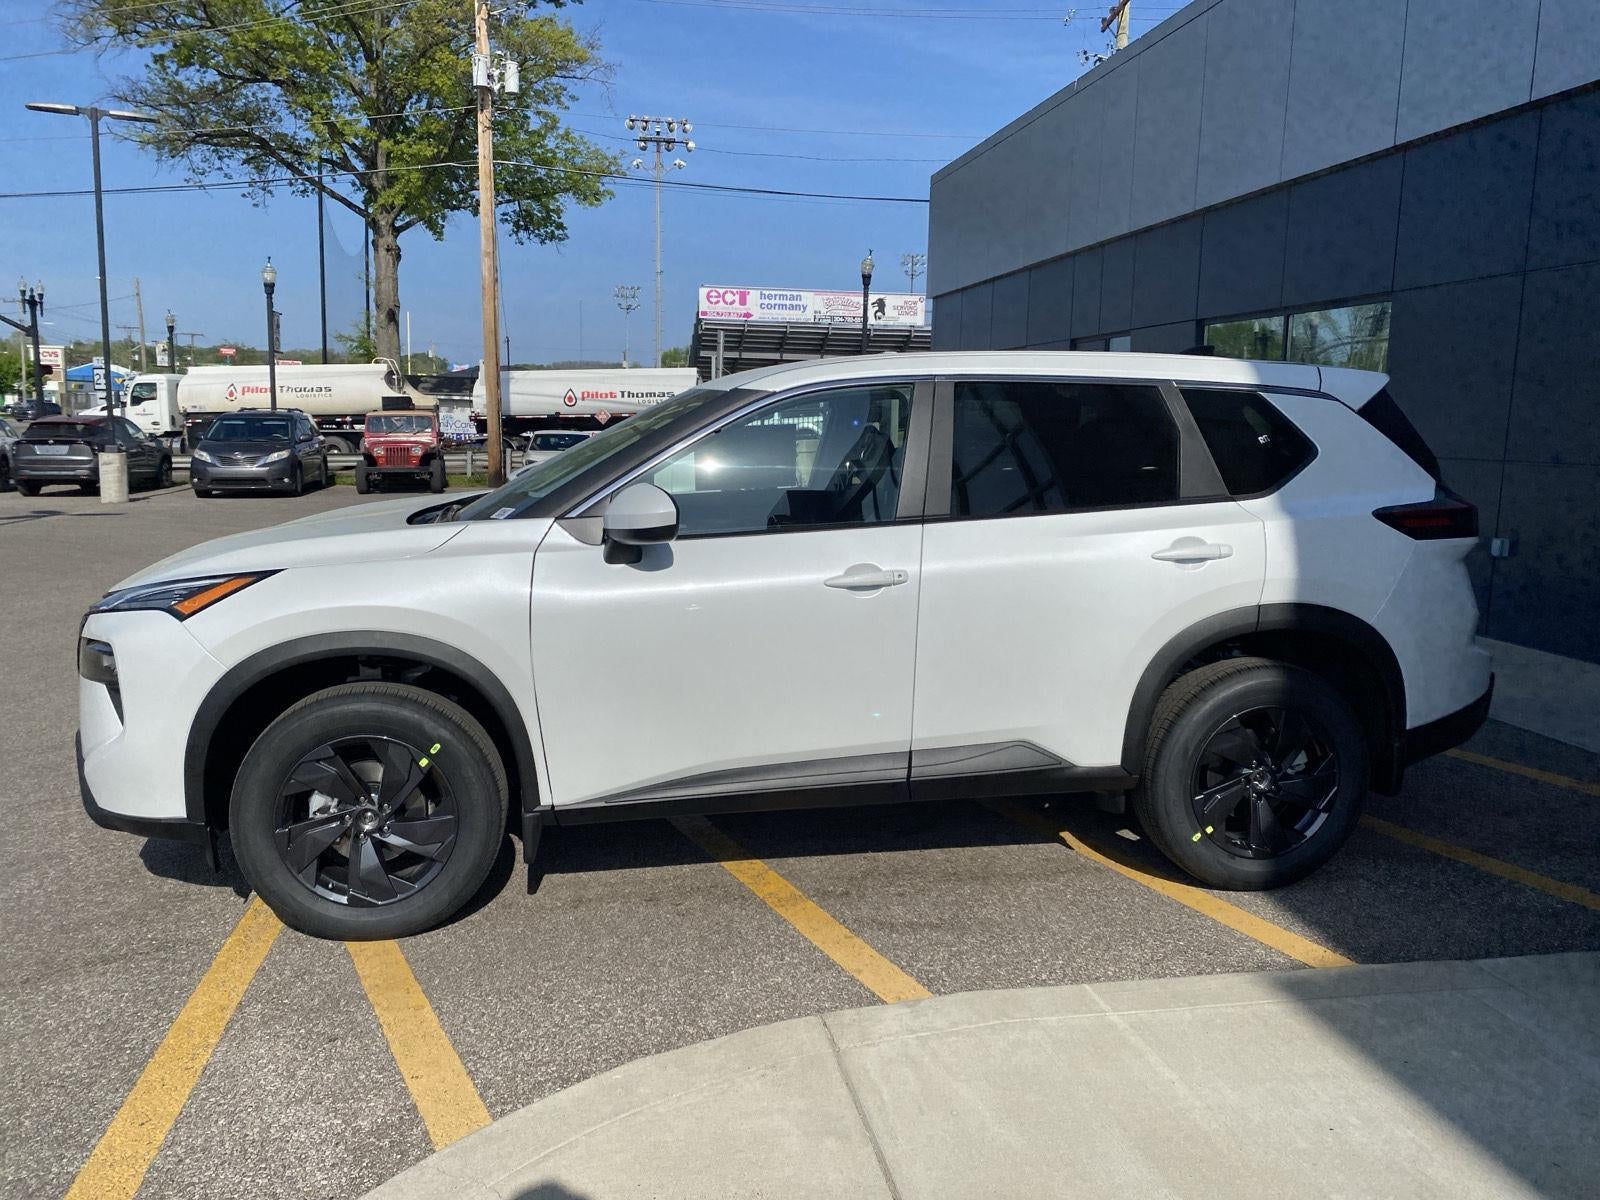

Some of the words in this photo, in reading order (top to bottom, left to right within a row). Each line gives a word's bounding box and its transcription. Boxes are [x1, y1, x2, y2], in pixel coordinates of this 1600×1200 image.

[760, 291, 802, 302] herman
[760, 302, 808, 313] cormany
[41, 350, 59, 358] CVS
[277, 385, 332, 393] Thomas
[580, 390, 617, 401] Pilot
[619, 390, 675, 399] Thomas
